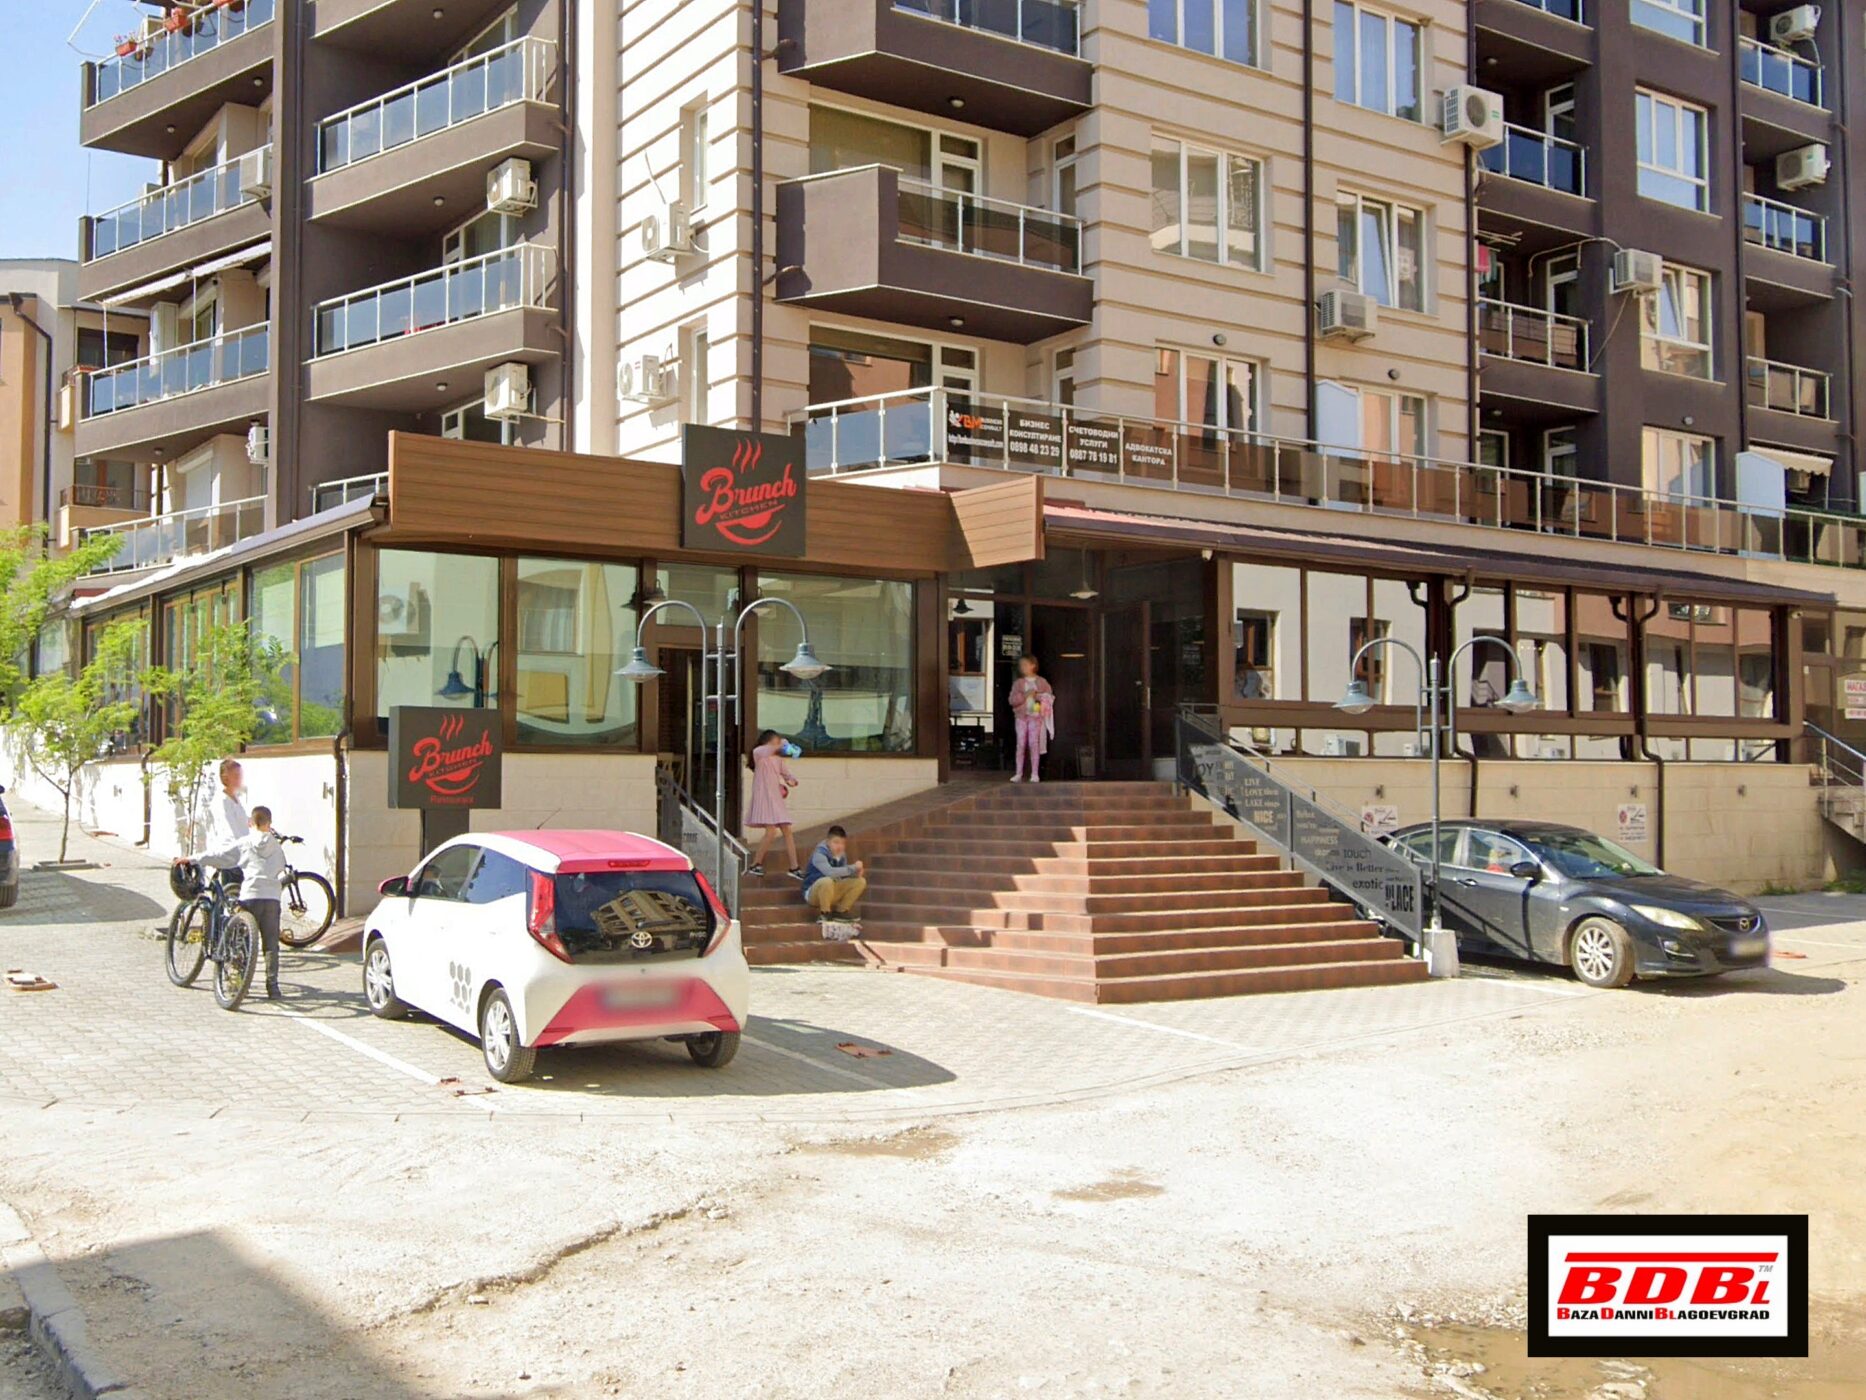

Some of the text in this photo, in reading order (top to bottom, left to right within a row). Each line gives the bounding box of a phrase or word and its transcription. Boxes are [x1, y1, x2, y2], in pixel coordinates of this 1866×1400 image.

[1019, 419, 1050, 430] БИЗНЕС
[1009, 429, 1062, 443] КОНСУЛТИРАНЕ
[1068, 426, 1119, 439] СЧЕТОВОДНИ
[1040, 444, 1050, 456] 23
[1079, 438, 1108, 449] УСЛУГИ
[1125, 443, 1173, 456] АДВОКАТСКА
[1132, 455, 1166, 466] КАНТОРА
[694, 463, 798, 526] Brunch
[408, 730, 494, 782] Brunch
[1352, 878, 1384, 890] exotic
[1385, 885, 1414, 912] PLACE
